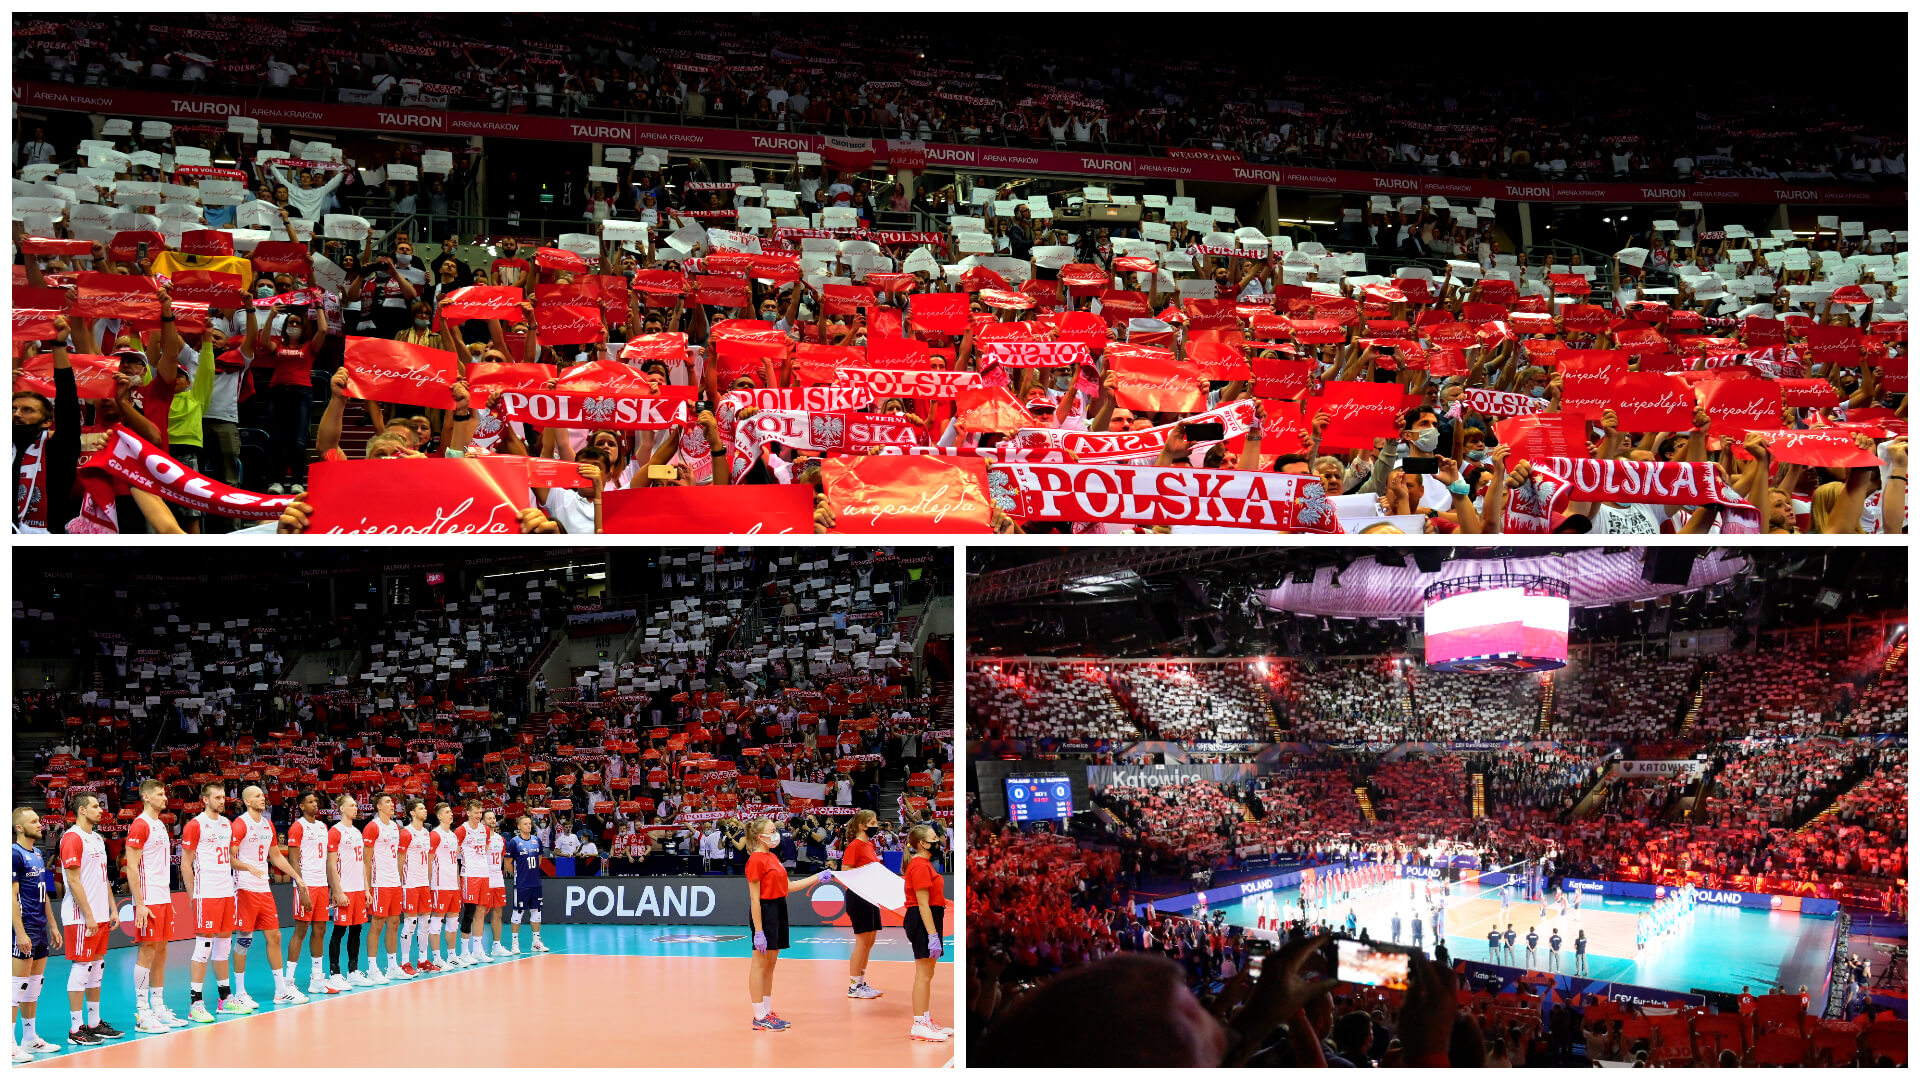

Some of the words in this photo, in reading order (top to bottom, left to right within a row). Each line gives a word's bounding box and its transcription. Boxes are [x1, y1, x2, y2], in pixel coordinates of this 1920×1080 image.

[34, 91, 69, 103] ARENA
[70, 94, 113, 106] KRAKÓW
[171, 100, 241, 115] TAURON
[251, 108, 282, 118] ARENA
[283, 110, 323, 120] KRAKÓW
[377, 112, 442, 127] TAURON
[452, 120, 482, 128] ARENA
[483, 121, 520, 131] KRAKÓW
[570, 124, 632, 139] TAURON
[640, 132, 668, 140] ARENA
[669, 133, 704, 143] KRAKÓW
[752, 136, 809, 150] TAURON
[923, 148, 975, 162] TAURON
[983, 155, 1007, 163] ARENA
[1008, 156, 1039, 164] KRAKÓW
[1170, 151, 1241, 161] WĘGORZEWO
[1081, 158, 1132, 171] TAURON
[1163, 165, 1192, 174] KRAKÓW
[1232, 168, 1280, 181] TAURON
[1310, 175, 1337, 184] KRAKÓW
[1373, 177, 1418, 190] TAURON
[1505, 185, 1550, 197] TAURON
[1641, 188, 1686, 198] TAURON
[1774, 190, 1818, 200] TAURON
[882, 231, 940, 243] POLSKA
[355, 363, 447, 387] niepodległa
[846, 368, 982, 397] POLSKA
[735, 387, 870, 413] POLSKA
[1621, 391, 1690, 417] niepodległa
[501, 392, 583, 421] POL
[614, 397, 685, 426] SKA
[1710, 397, 1777, 420] niepodległa
[850, 423, 917, 445] SKA
[113, 430, 297, 507] POLSK
[108, 459, 153, 488] GDAŃSK
[160, 486, 210, 509] SZCZECIN
[1552, 456, 1698, 498] POLSKA
[1016, 468, 1033, 514] BIAŁO
[1027, 466, 1278, 527] POLSKA
[842, 484, 976, 525] niepodległa
[1283, 479, 1293, 525] BIAŁO
[596, 637, 610, 648] A19
[1639, 762, 1697, 773] KATOWICE
[1112, 769, 1201, 789] Katowice
[1014, 788, 1024, 799] 0
[1056, 786, 1065, 796] 0
[686, 811, 726, 821] POLSKA
[216, 846, 230, 865] 20
[258, 844, 265, 861] 6
[353, 845, 363, 862] 15
[491, 852, 500, 865] 12
[526, 856, 536, 870] 10
[1406, 866, 1441, 878] POLAND
[1241, 879, 1274, 894] POLAND
[565, 885, 716, 917] POLAND
[205, 920, 213, 929] 20
[238, 919, 243, 927] 6
